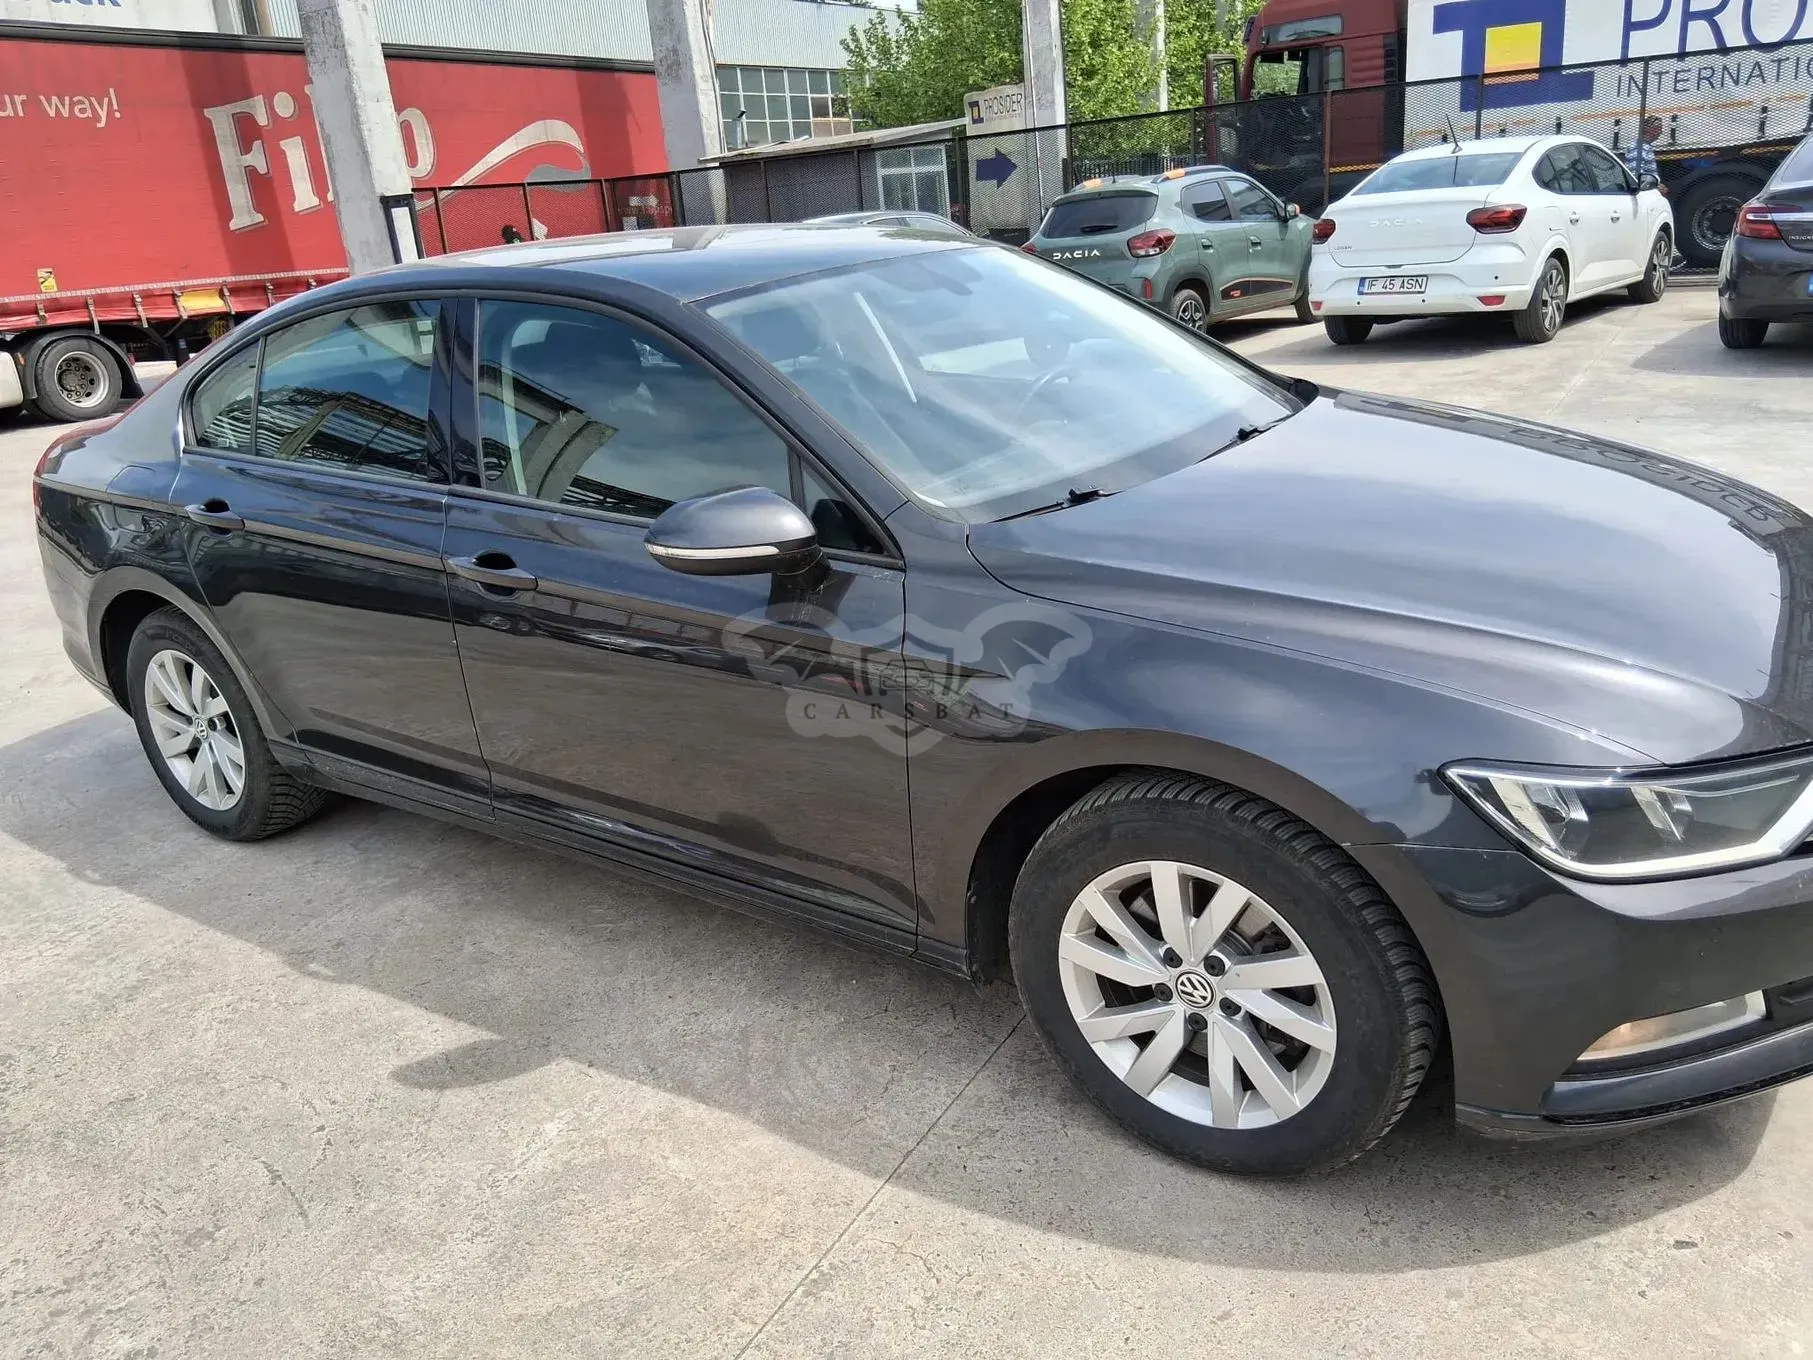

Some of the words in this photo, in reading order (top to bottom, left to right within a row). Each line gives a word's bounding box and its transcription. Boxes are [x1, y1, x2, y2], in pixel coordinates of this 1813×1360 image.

[1617, 56, 1813, 97] INTERNATI
[39, 88, 121, 128] way!
[983, 92, 1023, 117] PROSIDER
[1369, 218, 1423, 227] DACIA
[1053, 249, 1100, 260] DACIA
[1367, 280, 1378, 291] IF
[1381, 279, 1395, 290] 45
[1399, 278, 1424, 290] ASN
